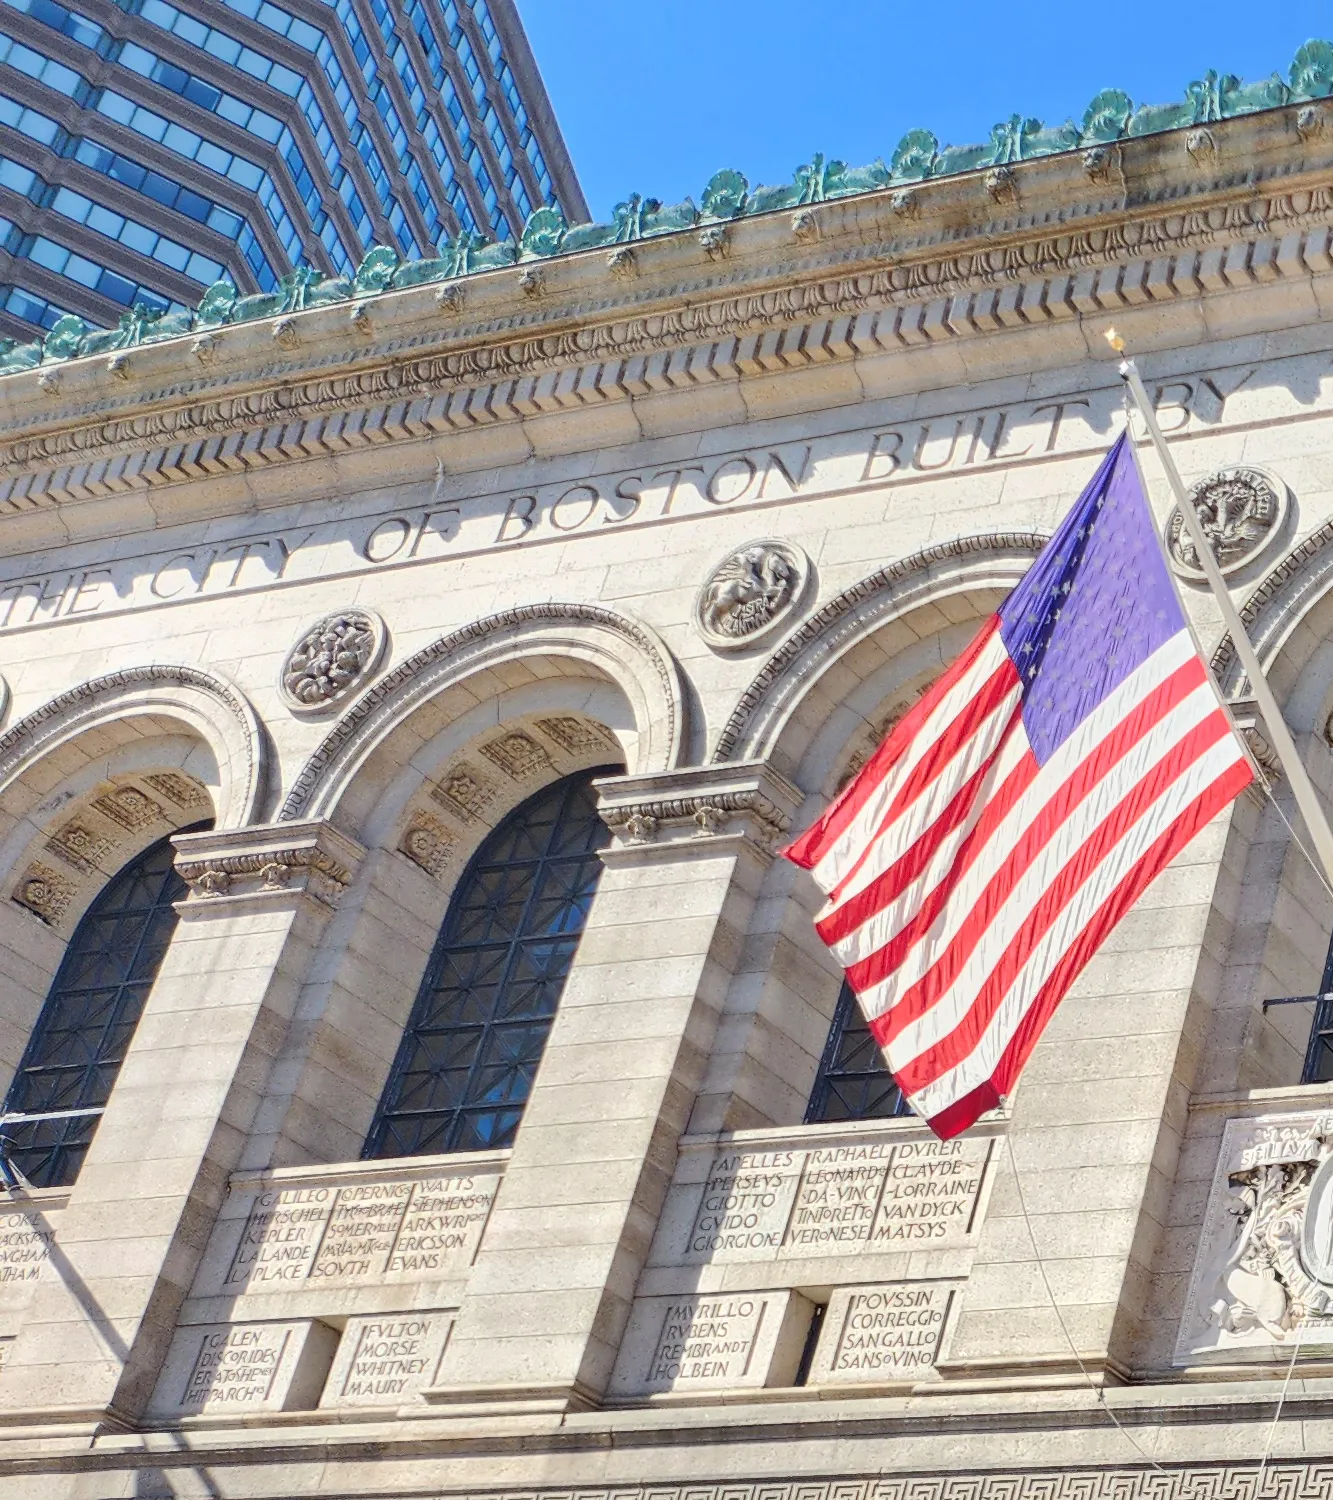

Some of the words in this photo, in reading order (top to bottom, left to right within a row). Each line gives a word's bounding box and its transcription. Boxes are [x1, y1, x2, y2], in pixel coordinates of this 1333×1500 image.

[0, 568, 114, 628] THE
[149, 530, 316, 601] CITY
[362, 506, 461, 565] OF
[494, 450, 816, 545] BOSTON
[859, 396, 1091, 482] BUILT
[810, 1146, 889, 1165] RAPHAEL
[898, 1141, 963, 1159] DVRER
[717, 1152, 794, 1171] APELLES
[420, 1177, 474, 1192] WATTS
[709, 1172, 785, 1191] PERSEVS
[260, 1188, 329, 1207] GALILEO
[704, 1193, 777, 1212] GIOTTO
[250, 1207, 328, 1227] HERSCHEL
[700, 1214, 759, 1232] GVIDO
[245, 1228, 307, 1244] KEPLER
[791, 1224, 868, 1244] VERONESE
[875, 1221, 948, 1241] MATSYS
[396, 1234, 467, 1251] ERICSSON
[692, 1232, 781, 1252] GIORGIONE
[238, 1245, 311, 1264] LALANDE
[390, 1254, 439, 1271] EVANS
[313, 1260, 371, 1277] SOVTH
[856, 1291, 934, 1310] POVSSIN
[670, 1301, 754, 1320] MVRILLO
[851, 1309, 943, 1329] CORREGGIO
[209, 1331, 263, 1347] GALEN
[365, 1321, 431, 1339] FVLTON
[665, 1322, 728, 1340] RVBENS
[358, 1340, 418, 1357] MORSE
[660, 1339, 751, 1361] REMBRANDT
[356, 1358, 431, 1376] WHITNEY
[838, 1351, 932, 1370] SANSOVINO
[653, 1362, 729, 1381] HOLBEIN
[347, 1377, 409, 1396] MAURY
